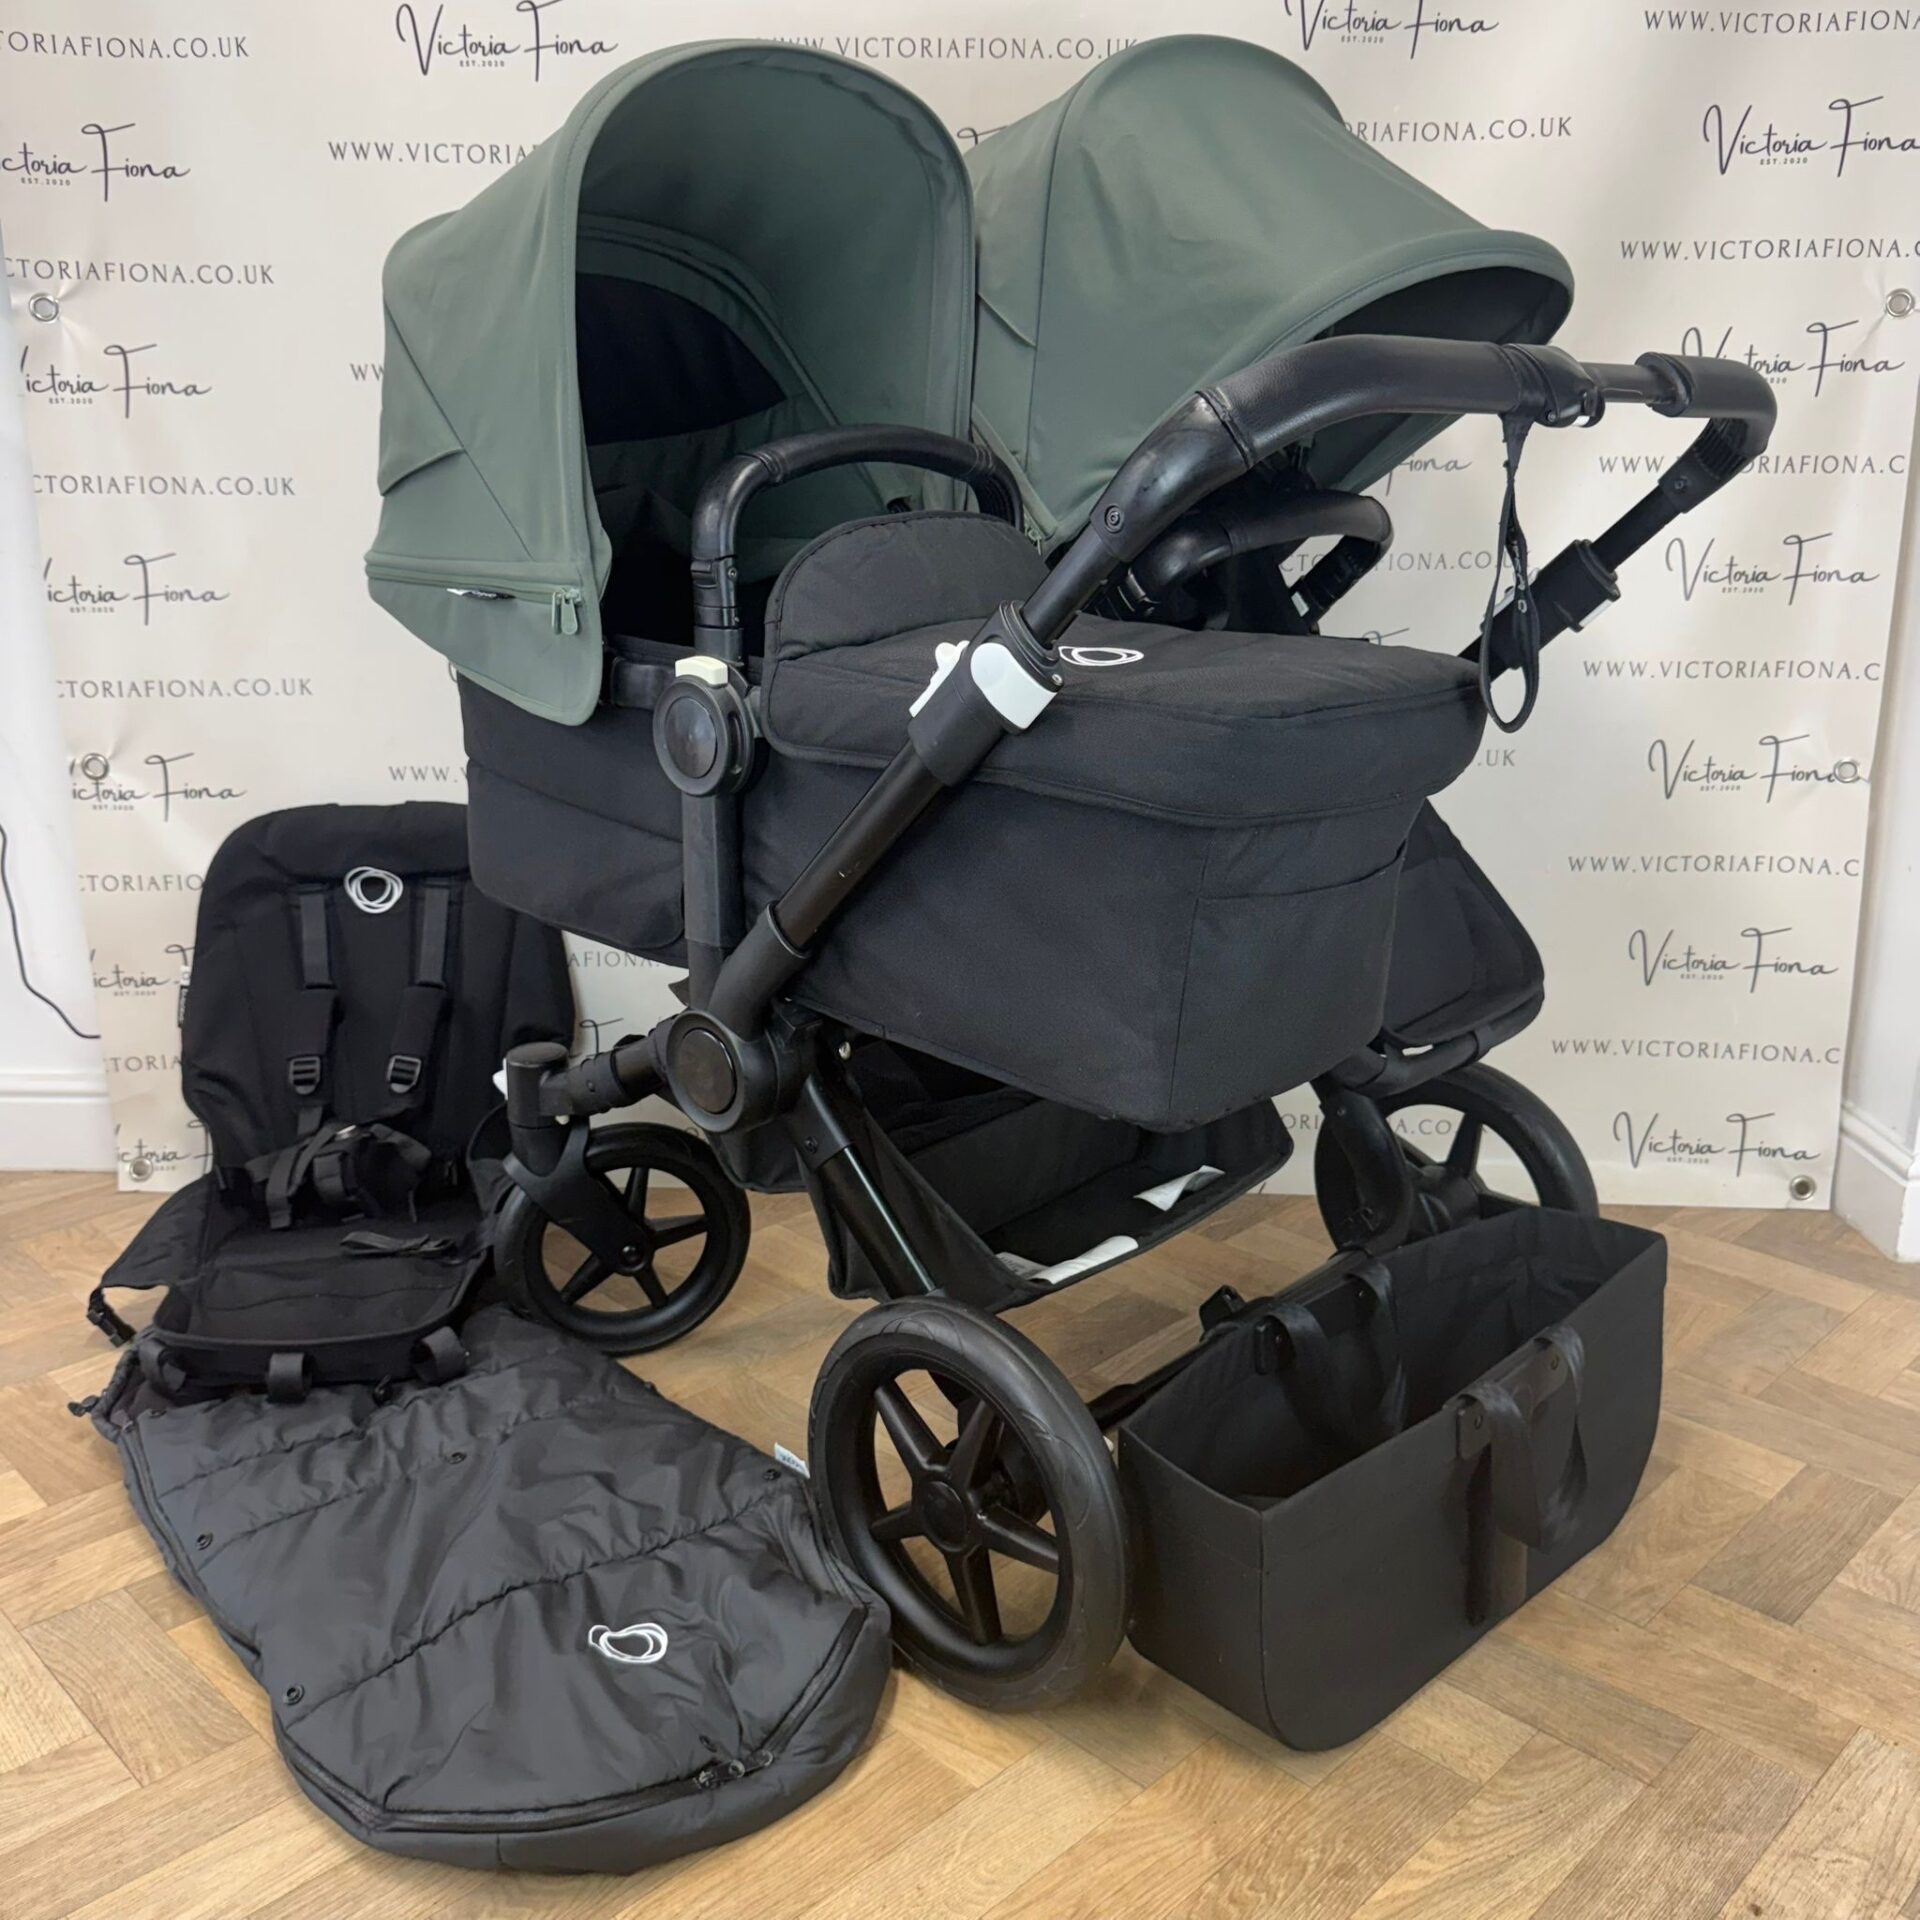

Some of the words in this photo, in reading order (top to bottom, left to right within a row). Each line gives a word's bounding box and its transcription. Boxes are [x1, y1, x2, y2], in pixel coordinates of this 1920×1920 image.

[0, 31, 249, 58] ORIAFIONA.CO.UK
[396, 3, 521, 76] Victoria
[516, 0, 619, 82] Fiona
[0, 142, 88, 176] ctoria
[81, 122, 191, 202] Fiona
[328, 141, 540, 165] WWW.VICTORIA
[1703, 104, 1828, 175] Victoria
[1828, 96, 1920, 178] Fiona
[1759, 157, 1809, 166] EST.2020
[20, 345, 110, 396] ictoria
[103, 343, 212, 419] Fiona
[1806, 320, 1905, 398] Fiona
[43, 557, 130, 605] ictoria
[123, 552, 230, 626] Fiona
[1665, 538, 1781, 602] Victoria
[1783, 532, 1880, 606] Fiona
[1583, 660, 1881, 682] WWW.VICTORIAFIONA.C
[69, 758, 150, 802] ictoria
[145, 752, 248, 823] Fiona
[1648, 739, 1757, 800] Victoria
[1759, 734, 1868, 803] Fion
[1568, 855, 1860, 877] WWW.VICTORIAFIONA.C
[89, 949, 171, 989] ictoria
[1628, 929, 1740, 987] Victoria
[1740, 927, 1839, 994] Fiona
[1552, 1039, 1841, 1064] WWW.VICTORIAFIONA.C
[1613, 1111, 1726, 1169] Victoria
[1726, 1112, 1821, 1178] Fiona
